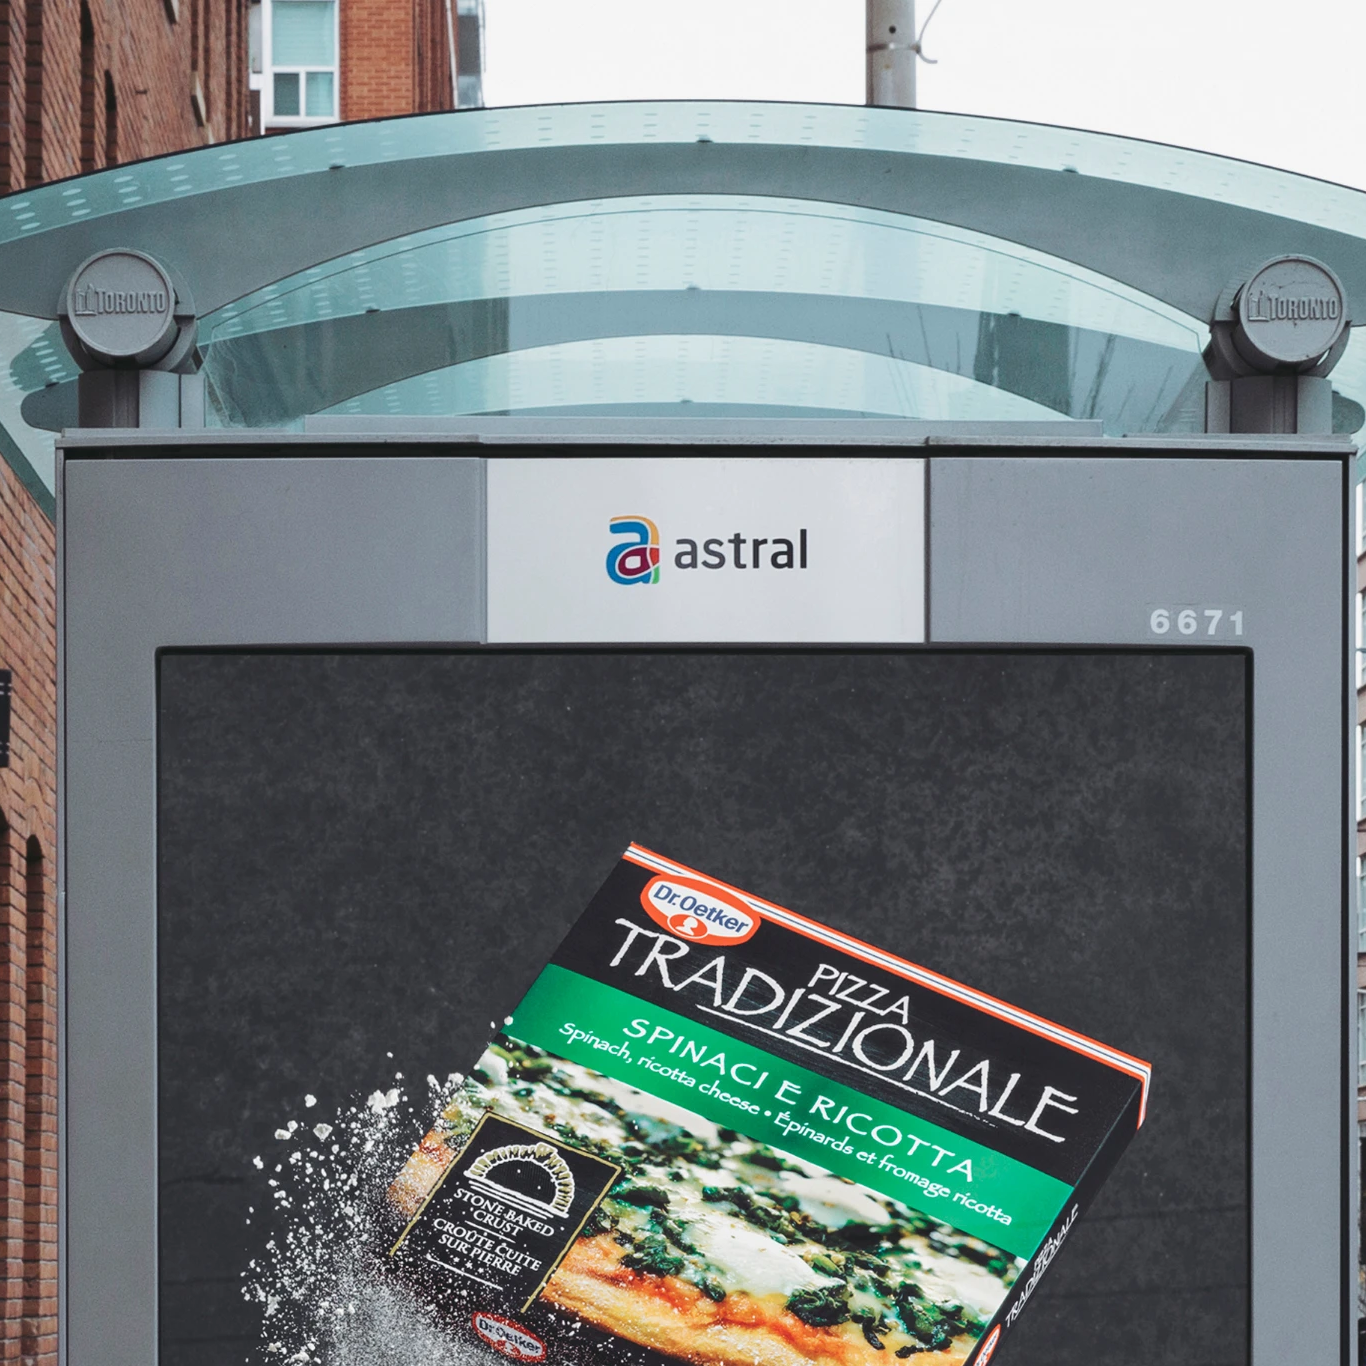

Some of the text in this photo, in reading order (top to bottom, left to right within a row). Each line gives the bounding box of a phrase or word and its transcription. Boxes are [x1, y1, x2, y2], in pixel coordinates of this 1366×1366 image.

[96, 288, 166, 314] TORONTO
[1268, 294, 1339, 320] TORONTO
[674, 529, 807, 570] astral
[1150, 608, 1243, 635] 6671
[809, 963, 910, 1024] PIZZA
[610, 918, 1079, 1143] TRADIZIONALE
[623, 1018, 974, 1183] SPINACI E RICOTTA
[558, 1022, 1012, 1226] Spinach, ricotta cheese Épinards et fromage ricotta
[453, 1187, 554, 1237] STONE BAKED
[473, 1209, 524, 1237] CRUST
[434, 1218, 542, 1271] CROÛTE CUITE
[438, 1233, 522, 1276] SUR PIERRE
